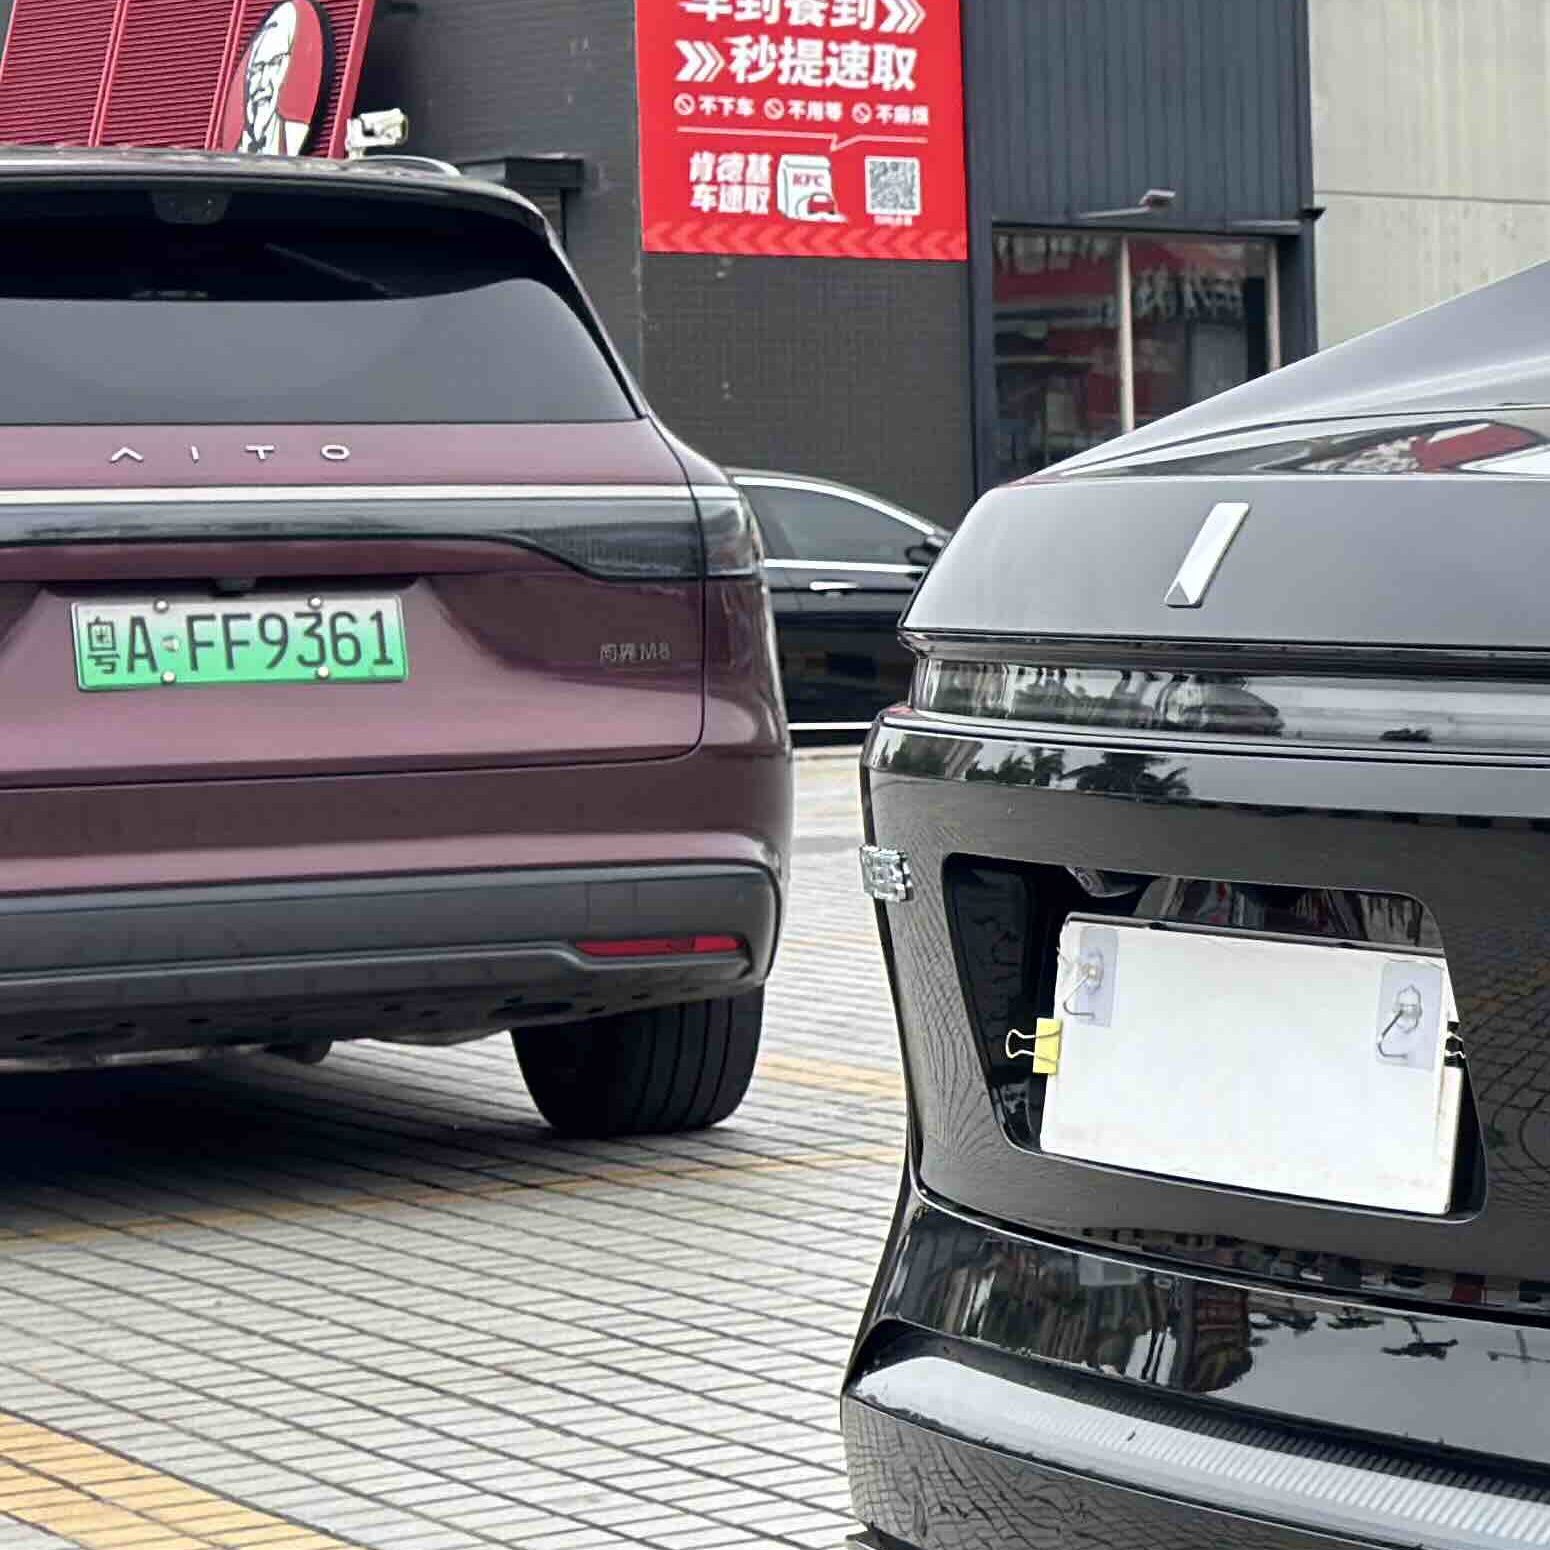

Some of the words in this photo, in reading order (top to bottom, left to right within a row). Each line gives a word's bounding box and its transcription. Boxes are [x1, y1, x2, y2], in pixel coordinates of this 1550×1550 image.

[727, 35, 918, 93] 秒提速取
[689, 150, 773, 183] 肯德基
[792, 173, 825, 188] KFC
